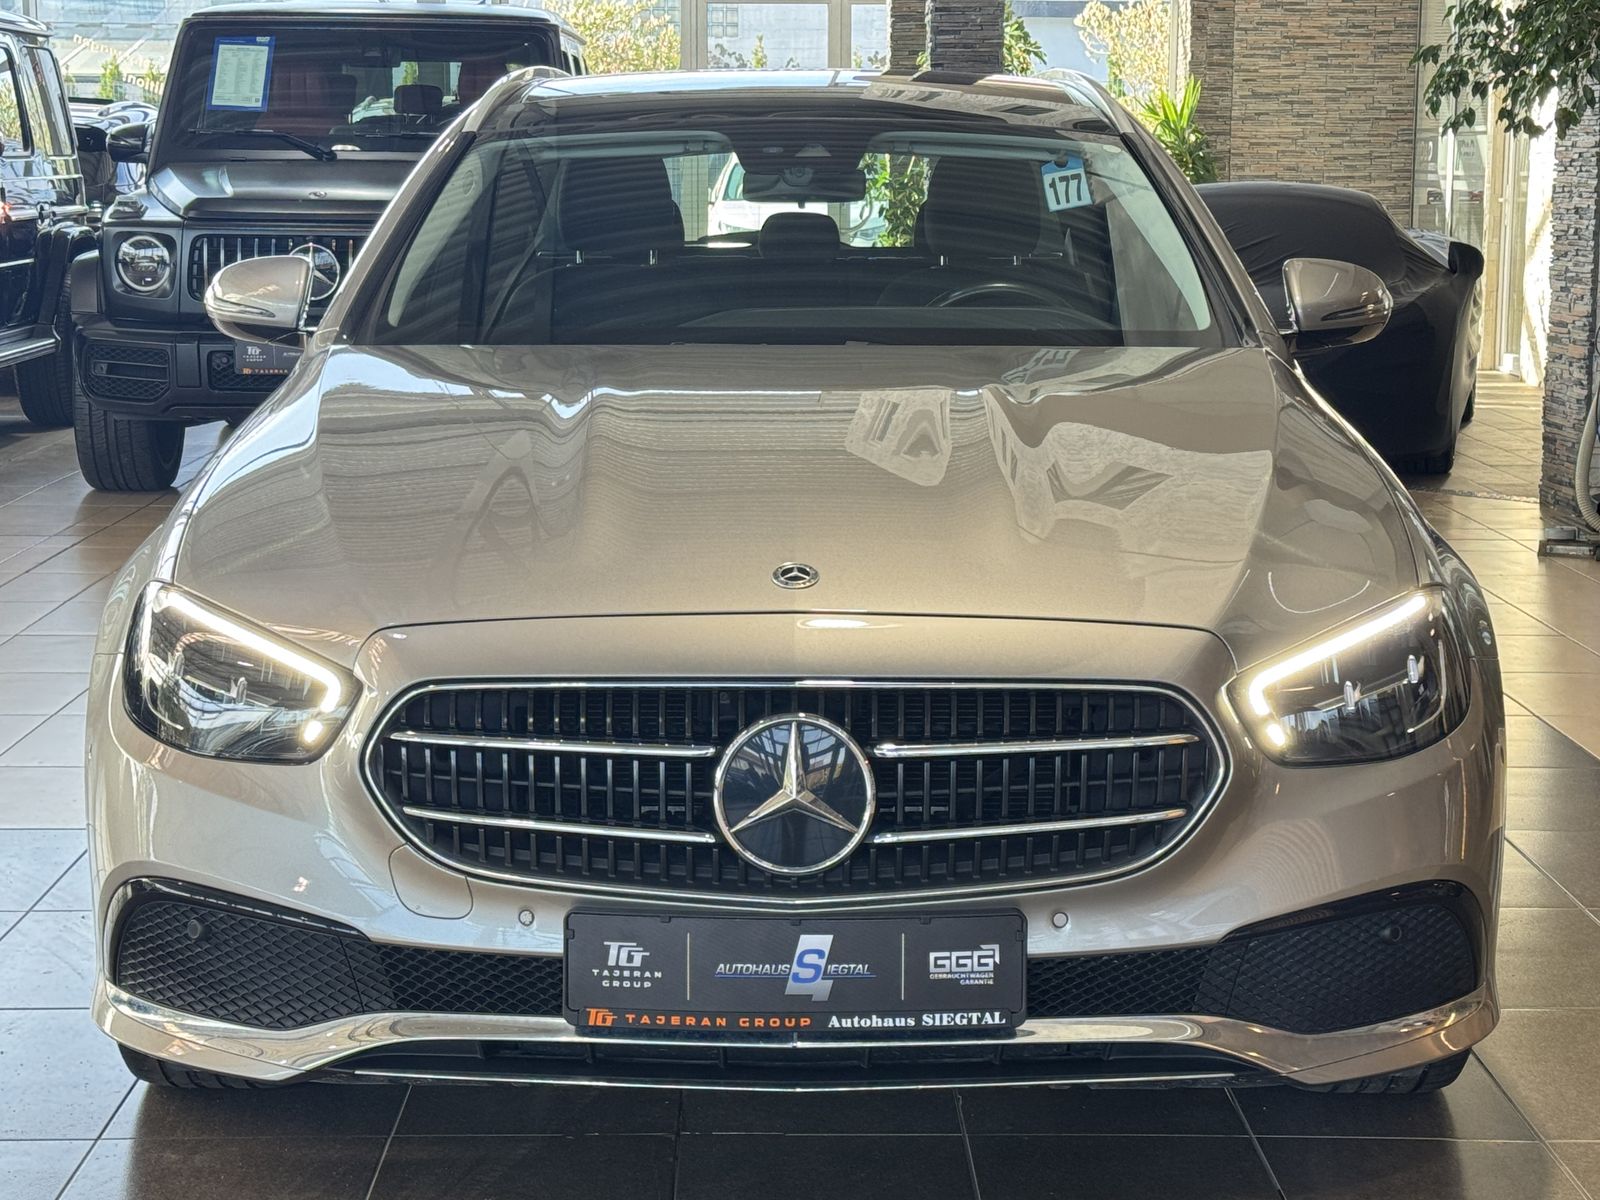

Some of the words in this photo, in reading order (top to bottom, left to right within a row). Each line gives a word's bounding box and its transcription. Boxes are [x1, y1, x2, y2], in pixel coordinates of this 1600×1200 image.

[1049, 173, 1082, 205] 177
[603, 941, 650, 967] TG
[929, 950, 994, 973] GGG
[592, 969, 662, 978] TAJERAN
[715, 963, 791, 975] AUTOHAUS
[929, 972, 995, 980] GEBRAUCHTWAGEN
[602, 980, 652, 988] GROUP
[586, 1008, 617, 1026] TG
[625, 1014, 727, 1027] TAJERAN
[739, 1017, 812, 1028] GROUP
[828, 1015, 916, 1028] Autohaus
[922, 1011, 1006, 1026] SIEGTAL
